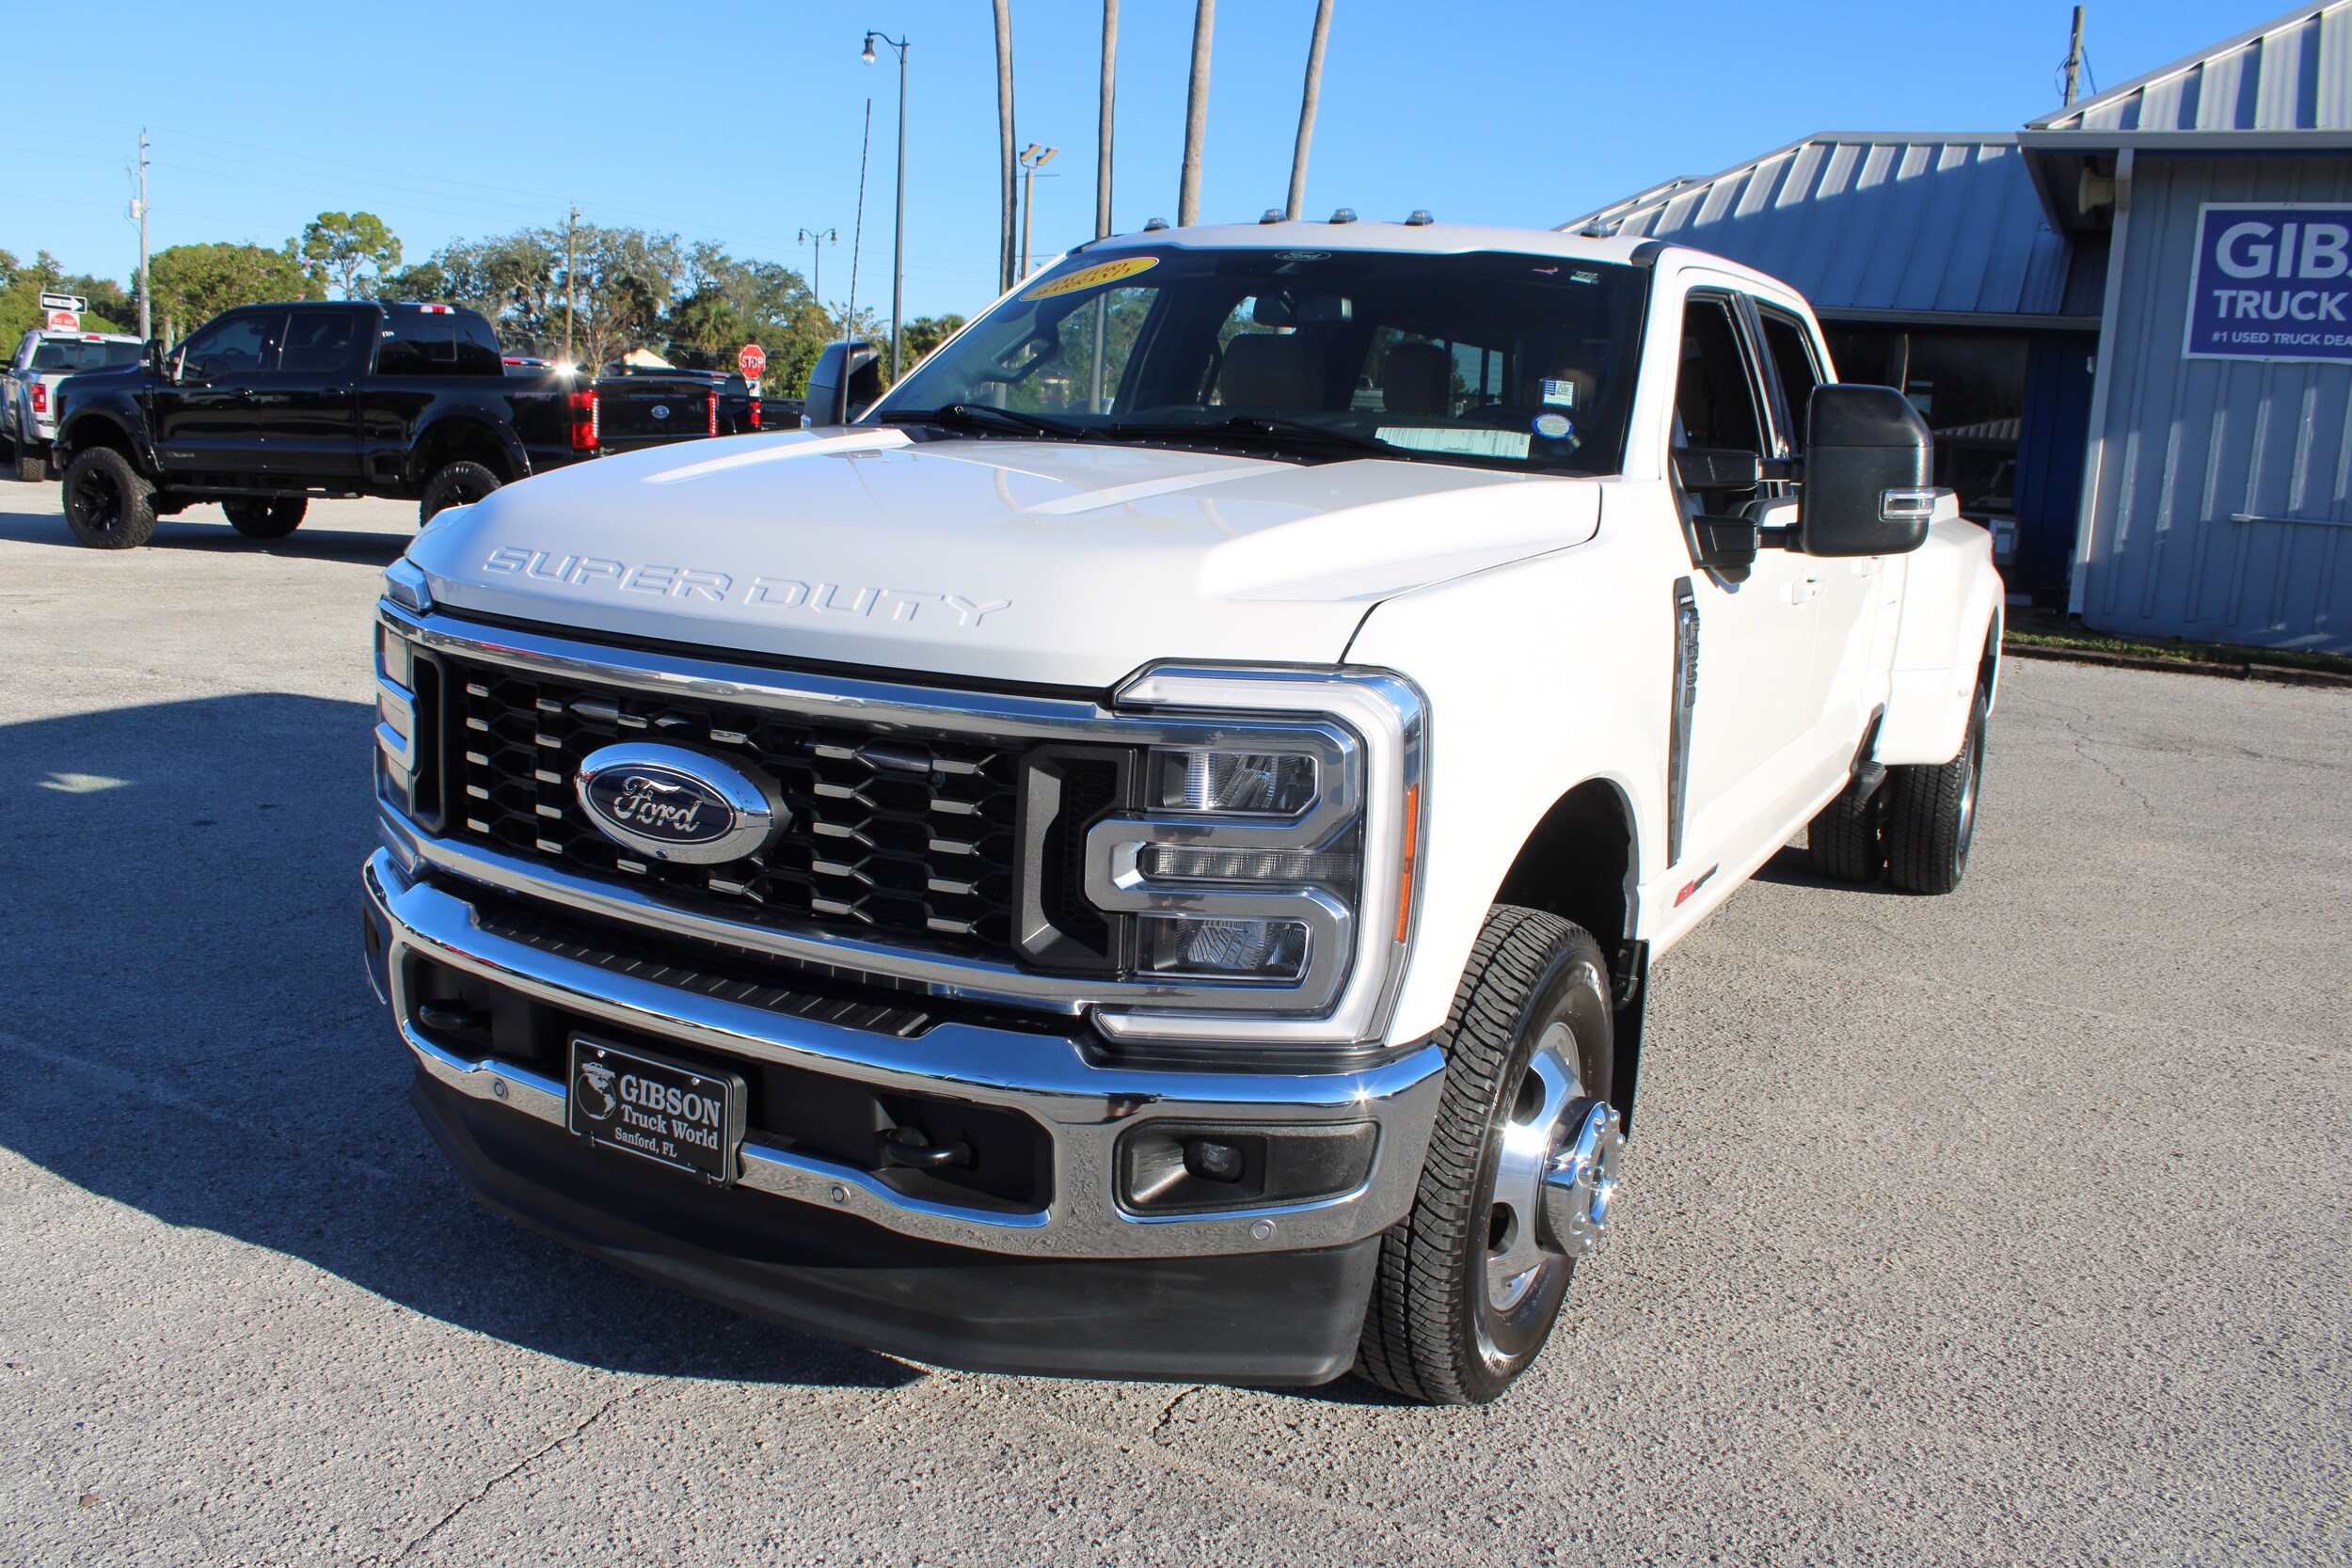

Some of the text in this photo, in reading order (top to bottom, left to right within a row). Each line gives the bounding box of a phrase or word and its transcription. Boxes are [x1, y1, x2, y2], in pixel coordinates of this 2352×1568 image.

[2216, 221, 2352, 278] GIB
[2213, 290, 2350, 321] TRUCK
[2212, 331, 2228, 342] #1
[2232, 332, 2269, 344] USED
[2273, 333, 2321, 345] TRUCK
[741, 355, 764, 370] STOP
[481, 546, 1013, 628] SUPER DUTY
[613, 776, 703, 832] Ford
[620, 1074, 722, 1128] GIBSON
[614, 1127, 677, 1158] Sanford, FL
[621, 1103, 719, 1150] Truck World
